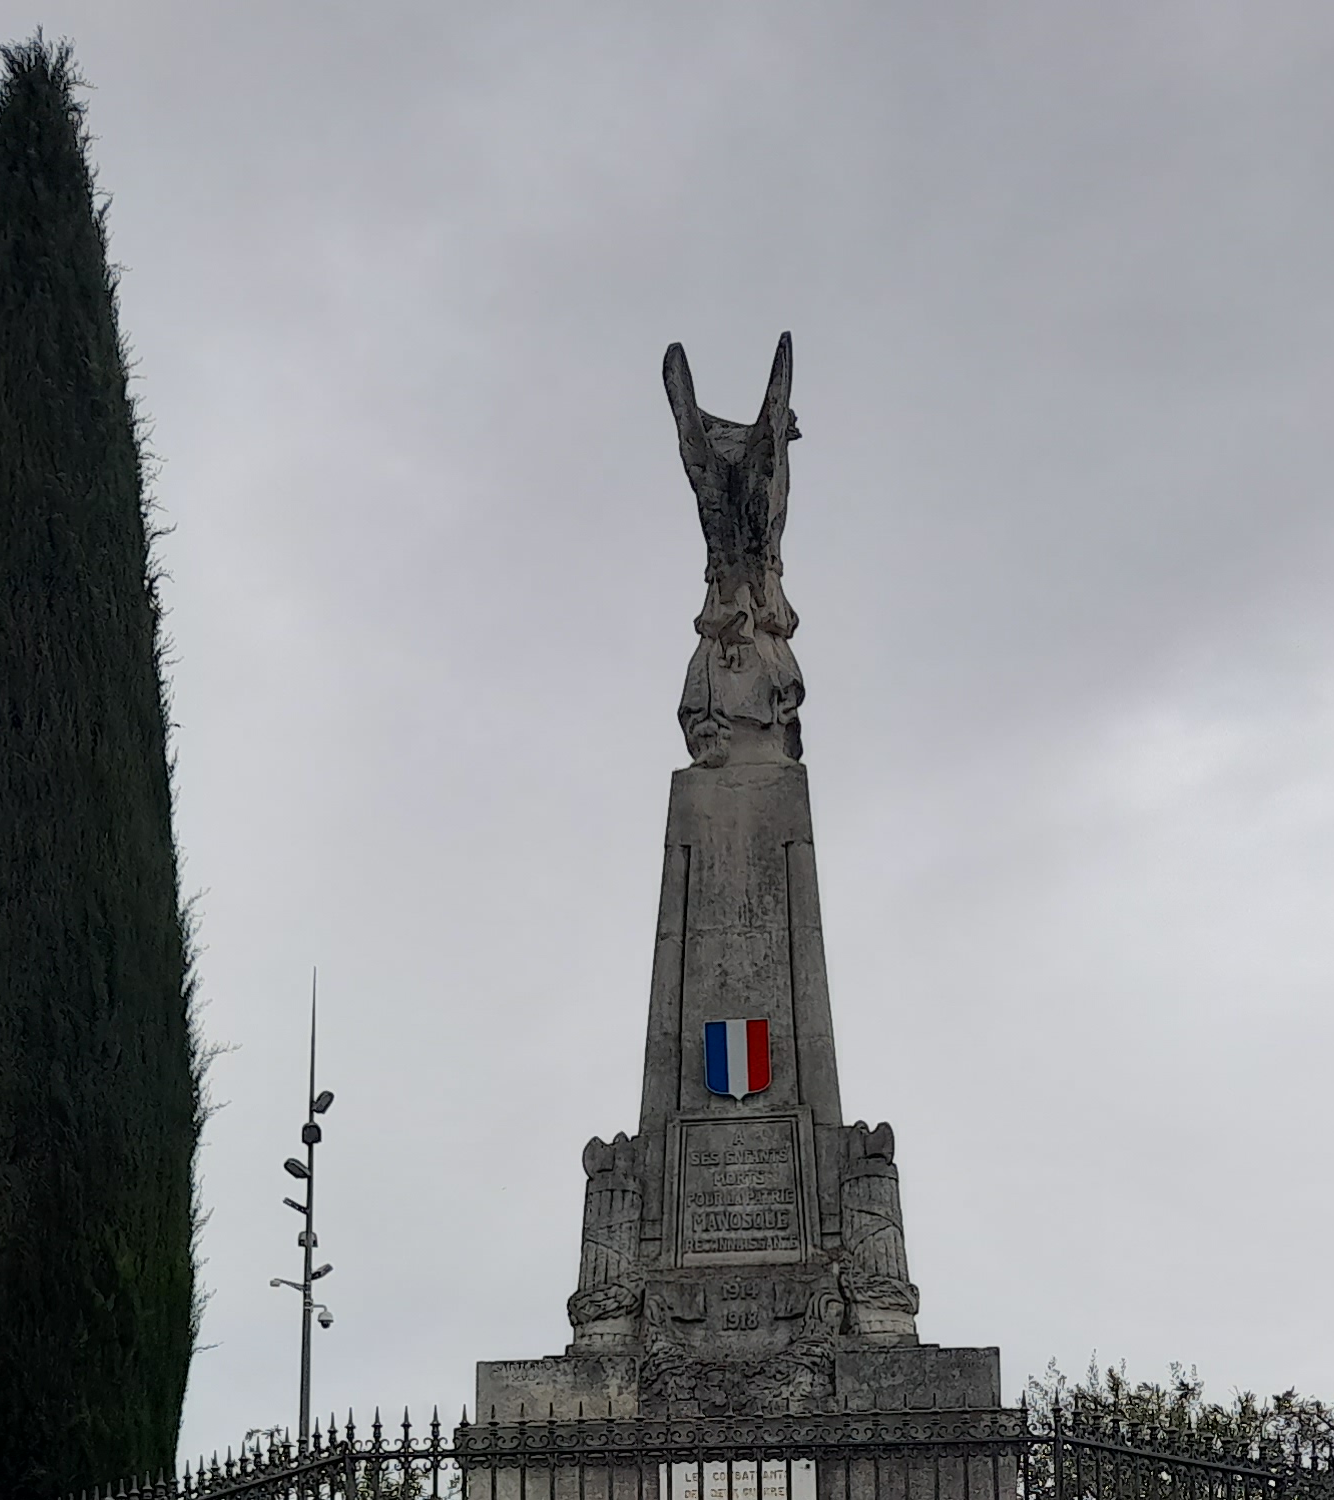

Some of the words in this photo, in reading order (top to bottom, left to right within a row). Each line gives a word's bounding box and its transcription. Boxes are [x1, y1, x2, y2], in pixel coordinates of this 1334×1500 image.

[732, 1129, 745, 1146] A
[690, 1151, 720, 1167] SES
[724, 1147, 788, 1166] ENFANTS
[713, 1171, 765, 1187] MORTS
[687, 1191, 724, 1208] POUR
[727, 1190, 743, 1206] LA
[747, 1188, 795, 1206] PATRIE
[692, 1210, 789, 1233] MANOSQUE
[722, 1283, 758, 1300] 1914
[722, 1311, 758, 1331] 1918
